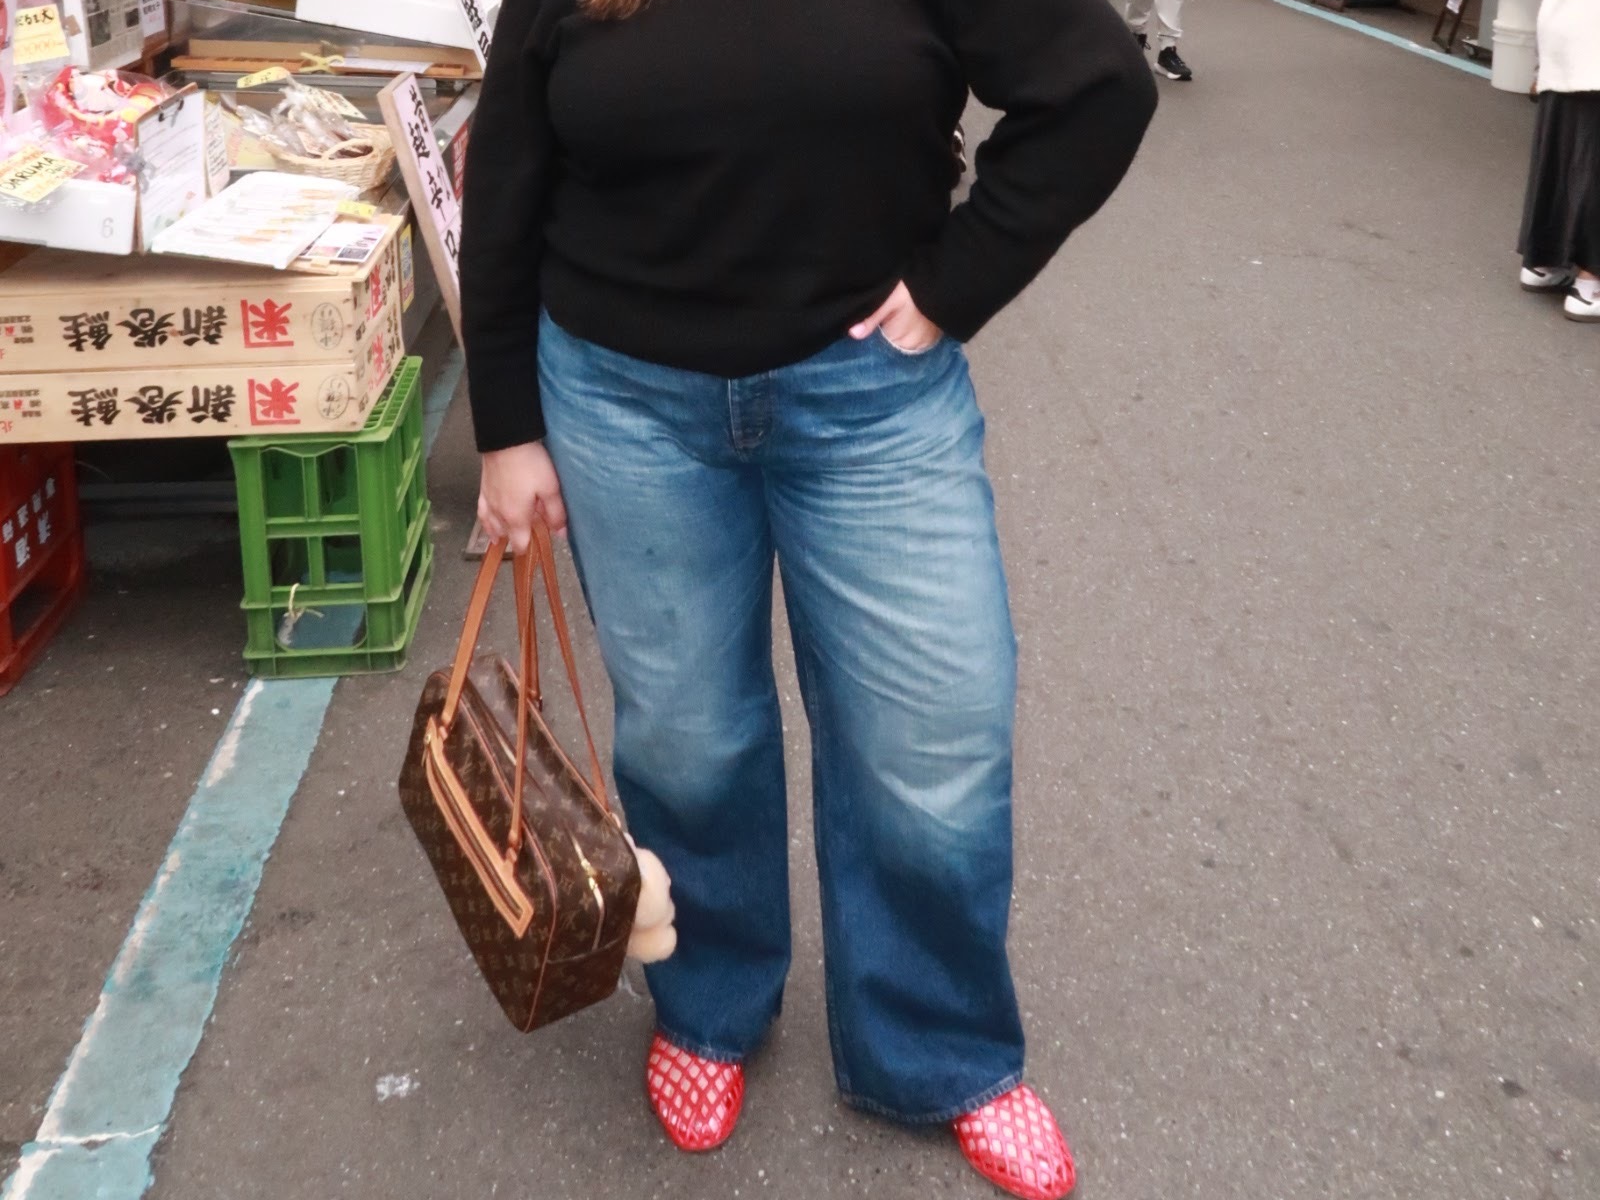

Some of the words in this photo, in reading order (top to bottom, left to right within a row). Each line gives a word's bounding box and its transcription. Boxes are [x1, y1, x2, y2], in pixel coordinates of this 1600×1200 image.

[0, 156, 55, 191] DARUMA
[58, 306, 227, 351] 新巻鮭
[67, 384, 237, 427] 新巻鮭
